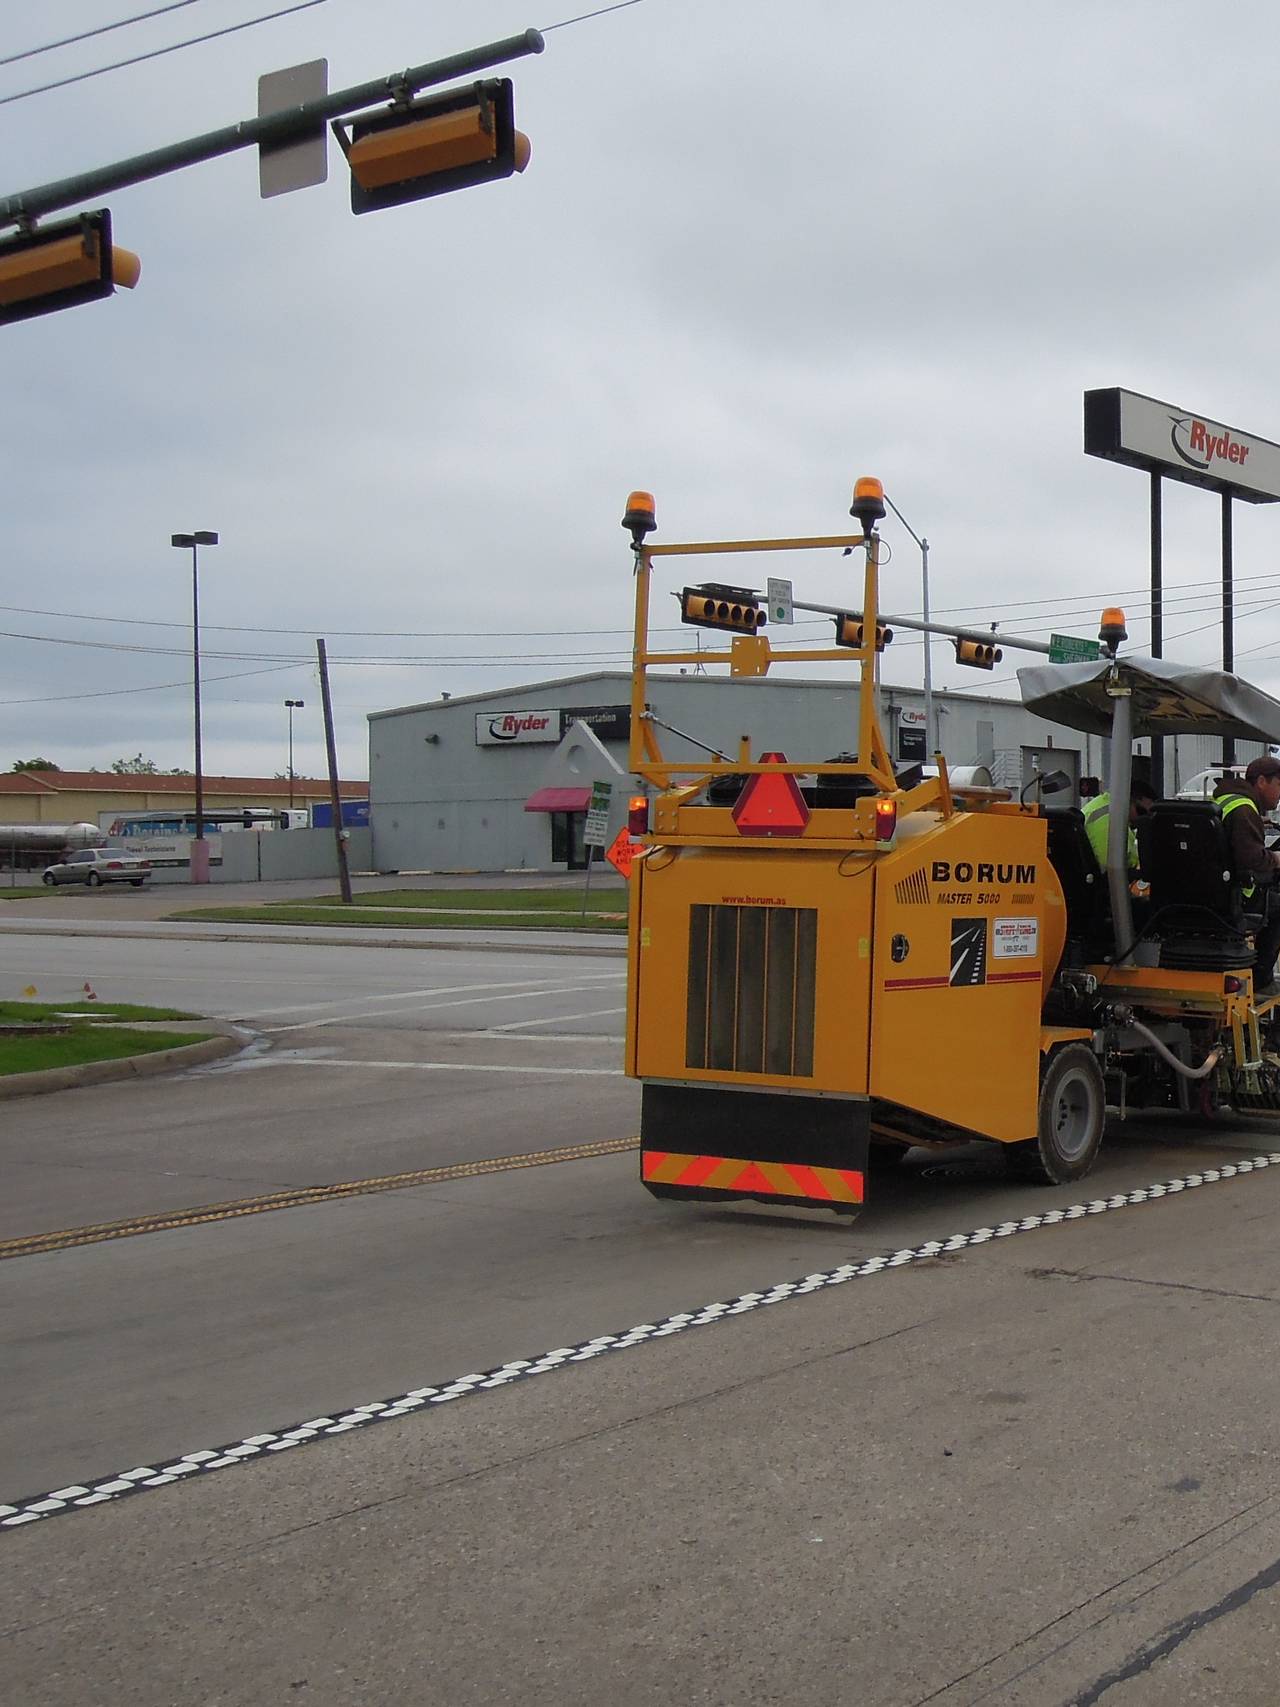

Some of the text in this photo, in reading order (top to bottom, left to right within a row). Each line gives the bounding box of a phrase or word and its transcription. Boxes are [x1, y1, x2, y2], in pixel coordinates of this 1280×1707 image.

[1190, 420, 1249, 465] Ryder
[502, 715, 549, 735] Ryder
[931, 861, 1036, 884] BORUM
[721, 895, 786, 905] www.borum.as
[937, 892, 1001, 905] MASTER 5000
